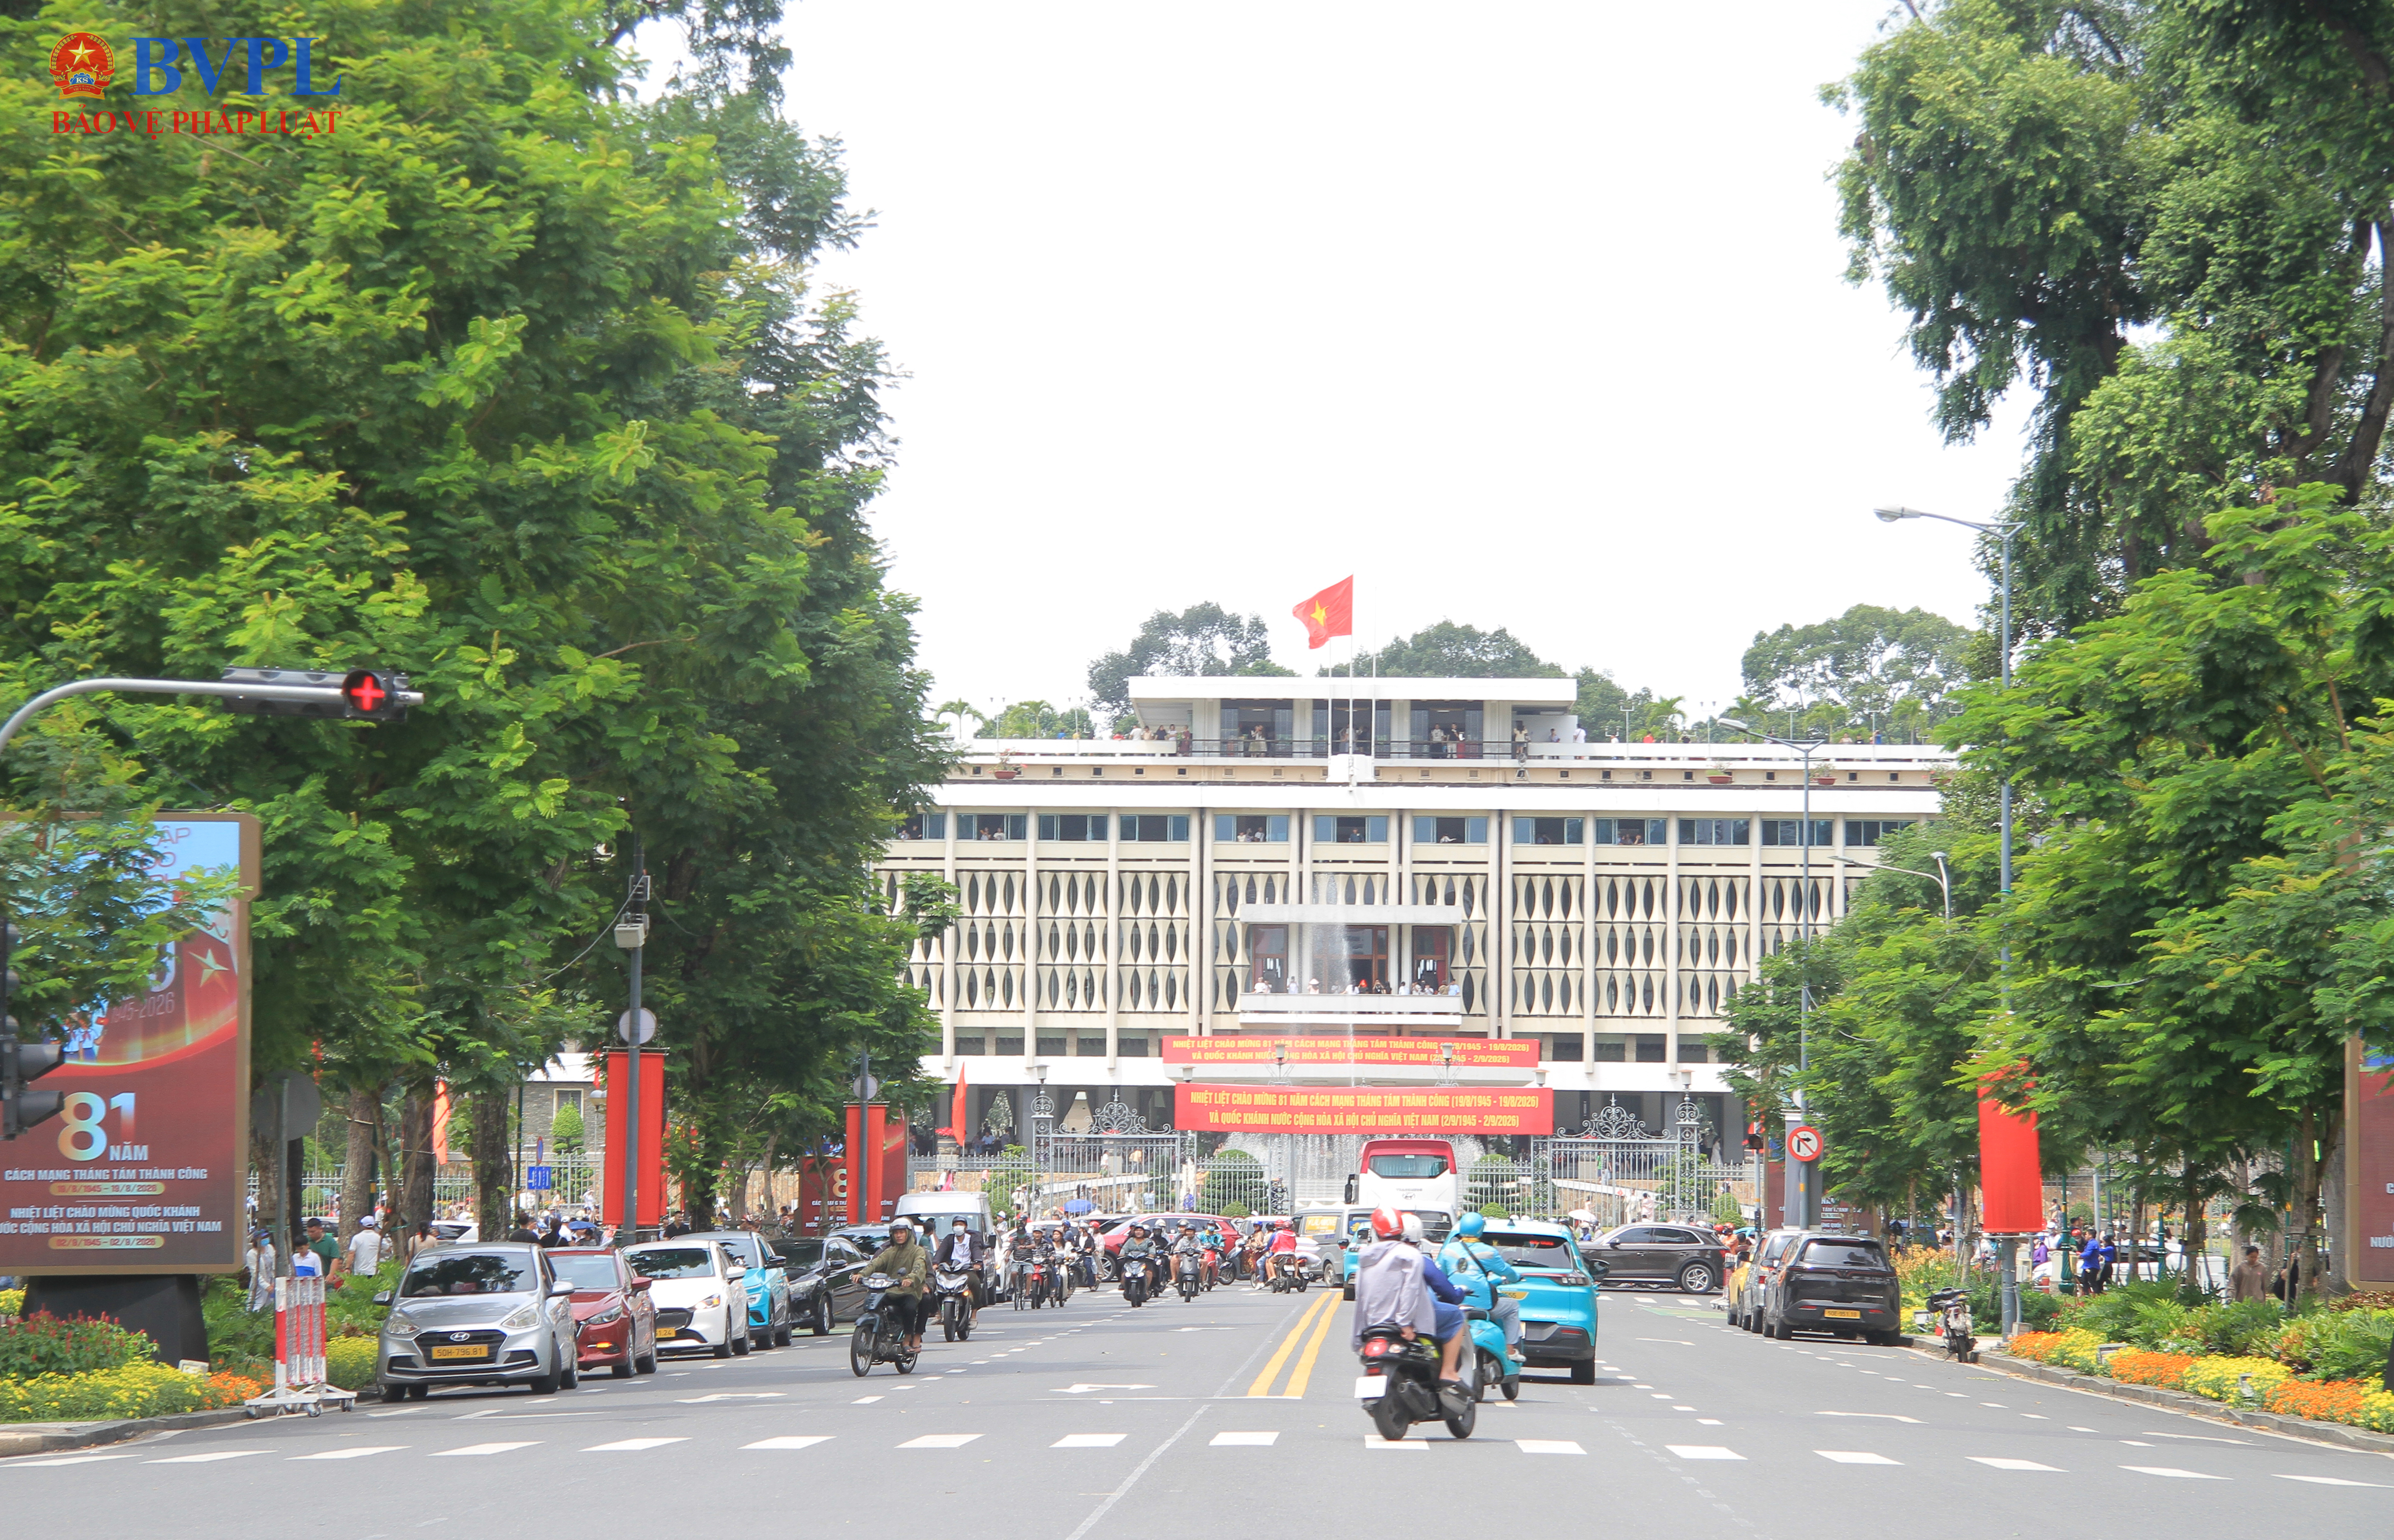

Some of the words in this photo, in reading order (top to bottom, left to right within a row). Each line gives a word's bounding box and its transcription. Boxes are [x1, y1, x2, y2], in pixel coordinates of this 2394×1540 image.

[1173, 1039, 1196, 1049] NHIỆT
[1197, 1039, 1213, 1049] LIỆT
[1214, 1039, 1236, 1048] CHÀO
[1237, 1039, 1261, 1048] MỪNG
[1294, 1039, 1315, 1048] CÁCH
[1317, 1040, 1341, 1049] MẠNG
[1343, 1039, 1368, 1048] THÁNG
[1370, 1039, 1387, 1048] TÁM
[1389, 1040, 1415, 1049] THÀNH
[1417, 1040, 1438, 1049] CÔNG
[1489, 1043, 1529, 1052] 19/8/2026)
[1192, 1051, 1202, 1060] VÀ
[1204, 1050, 1225, 1060] QUỐC
[1226, 1051, 1253, 1060] KHÁNH
[1255, 1051, 1276, 1060] NƯỚC
[1284, 1051, 1300, 1061] ỘNG
[1302, 1050, 1318, 1060] HÒA
[1320, 1051, 1330, 1060] XÃ
[1332, 1051, 1345, 1061] HỘI
[1347, 1050, 1363, 1060] CHỦ
[1365, 1051, 1389, 1060] NGHĨA
[1391, 1052, 1407, 1062] VIỆT
[1473, 1055, 1510, 1064] 2/9/2026)
[1191, 1090, 1213, 1106] NHIỆT
[1214, 1091, 1230, 1107] LIỆT
[1232, 1091, 1252, 1105] CHÀO
[1254, 1092, 1277, 1106] MỪNG
[1278, 1094, 1287, 1106] 81
[1289, 1093, 1308, 1106] NĂM
[1310, 1093, 1330, 1106] CÁCH
[1332, 1095, 1355, 1109] MẠNG
[1356, 1093, 1381, 1107] THÁNG
[1383, 1094, 1400, 1107] TÁM
[1402, 1093, 1427, 1107] THÀNH
[1428, 1094, 1449, 1107] CÔNG
[1451, 1095, 1491, 1108] (19/8/1945
[1499, 1095, 1538, 1108] 19/8/2026)
[58, 1092, 136, 1161] 81
[1209, 1110, 1219, 1123] VÀ
[1221, 1109, 1242, 1125] QUỐC
[1243, 1111, 1269, 1124] KHÁNH
[1271, 1112, 1292, 1125] NƯỚC
[1294, 1112, 1314, 1128] CỘNG
[1316, 1112, 1332, 1126] HÒA
[1333, 1112, 1344, 1126] XÃ
[1346, 1112, 1359, 1128] HỘI
[1360, 1111, 1376, 1126] CHỦ
[1378, 1113, 1401, 1126] NGHĨA
[1403, 1113, 1420, 1128] VIỆT
[1421, 1115, 1439, 1126] NAM
[1441, 1115, 1476, 1127] (2/9/1945
[1483, 1115, 1519, 1127] 2/9/2026)
[109, 1142, 148, 1161] NĂM
[4, 1168, 35, 1181] CÁCH
[37, 1169, 71, 1183] MẠNG
[73, 1167, 110, 1180] THÁNG
[112, 1167, 136, 1180] TÁM
[138, 1166, 175, 1180] THÀNH
[178, 1166, 207, 1180] CÔNG
[10, 1205, 42, 1220] NHIỆT
[43, 1205, 66, 1220] LIỆT
[66, 1205, 96, 1218] CHÀO
[98, 1205, 130, 1218] MỪNG
[132, 1204, 161, 1219] QUỐC
[163, 1204, 201, 1217] KHÁNH
[20, 1221, 49, 1236] CỘNG
[51, 1221, 73, 1233] HÒA
[75, 1220, 90, 1233] XÃ
[92, 1220, 111, 1235] HỘI
[113, 1219, 136, 1232] CHỦ
[136, 1219, 170, 1232] NGHĨA
[172, 1219, 195, 1234] VIỆT
[196, 1221, 222, 1232] NAM
[2370, 1234, 2394, 1248] NƯỚ
[437, 1348, 482, 1357] 50H-796.81
